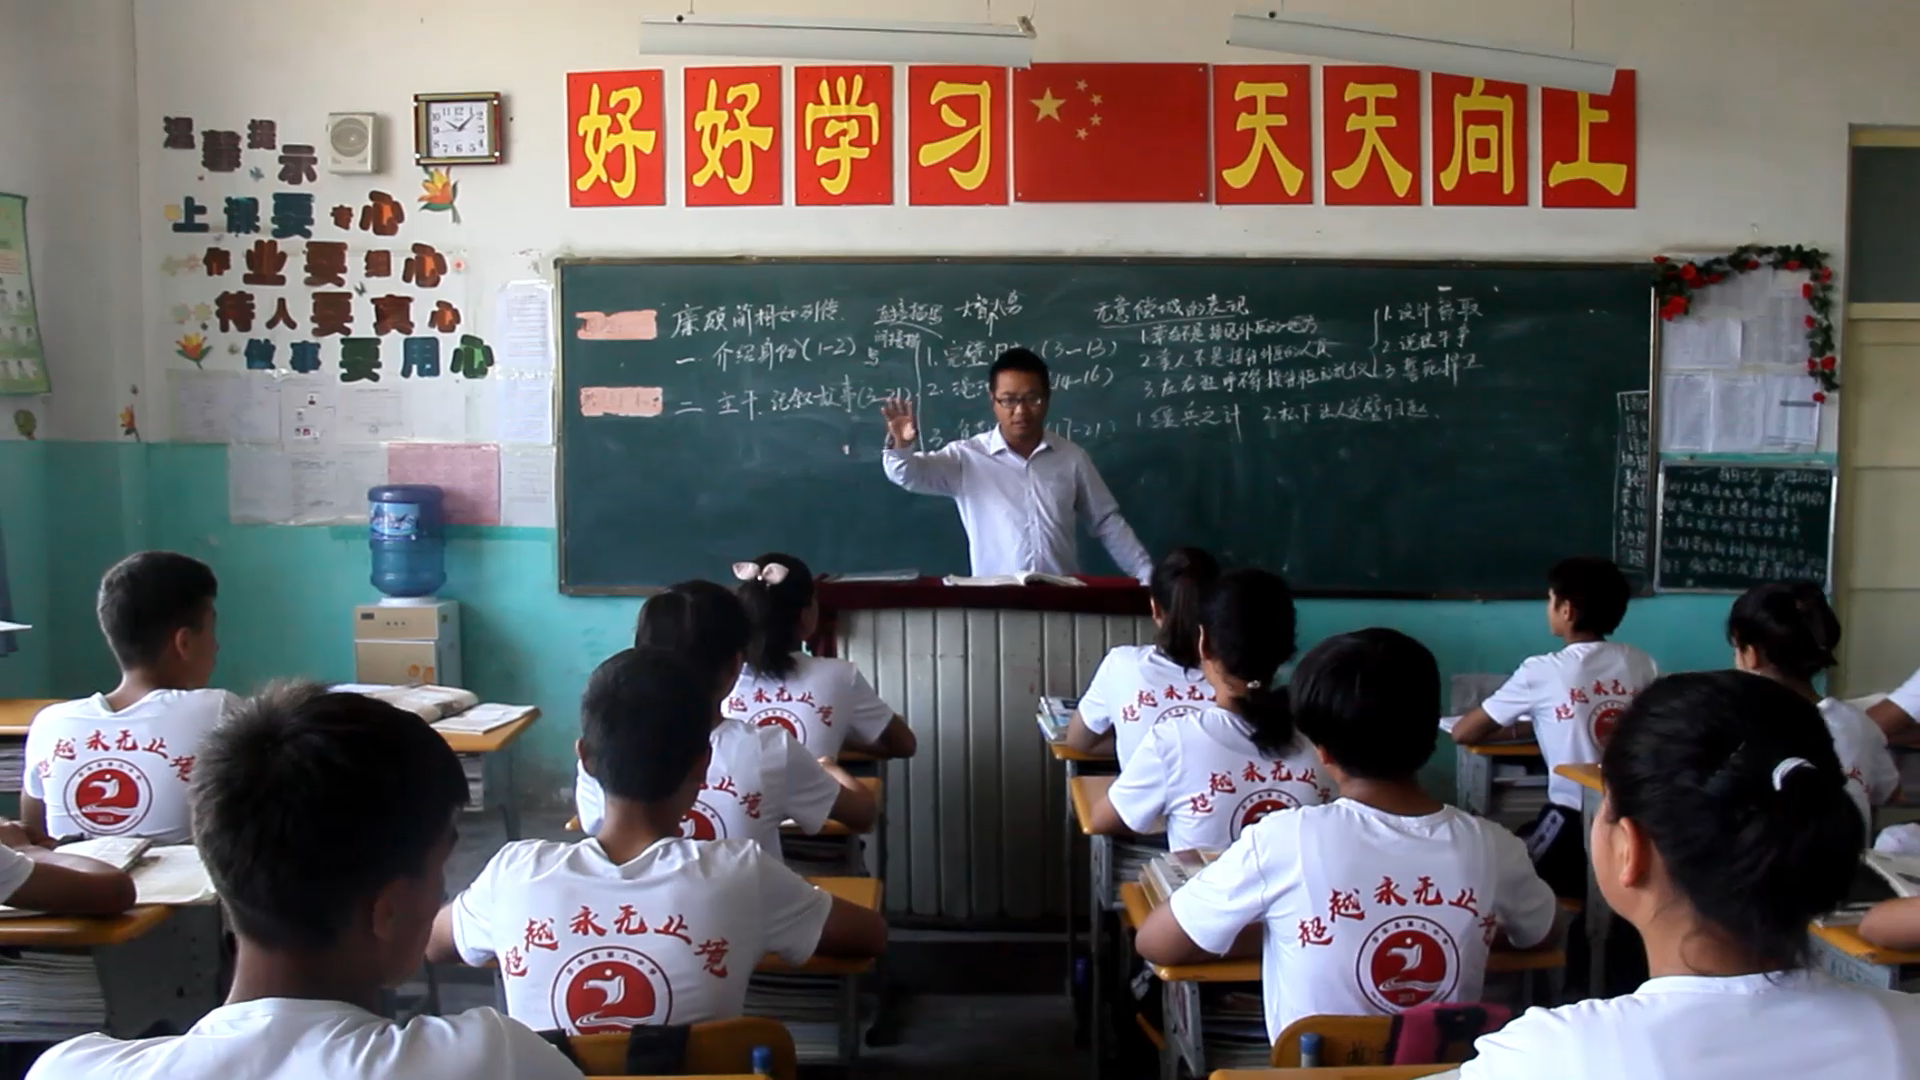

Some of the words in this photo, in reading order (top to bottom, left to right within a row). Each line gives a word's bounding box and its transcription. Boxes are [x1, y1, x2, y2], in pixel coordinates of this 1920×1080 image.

[163, 115, 318, 186] 温馨提示
[576, 73, 992, 198] 好好学习
[1221, 77, 1628, 198] 天天向上
[172, 190, 405, 239] 上课要专心
[203, 240, 448, 288] 作业要细心
[215, 290, 461, 337] 待人要真心
[244, 334, 494, 382] 做事要用心
[1121, 684, 1217, 724] 超越永无
[504, 904, 730, 980] 超越永无止境
